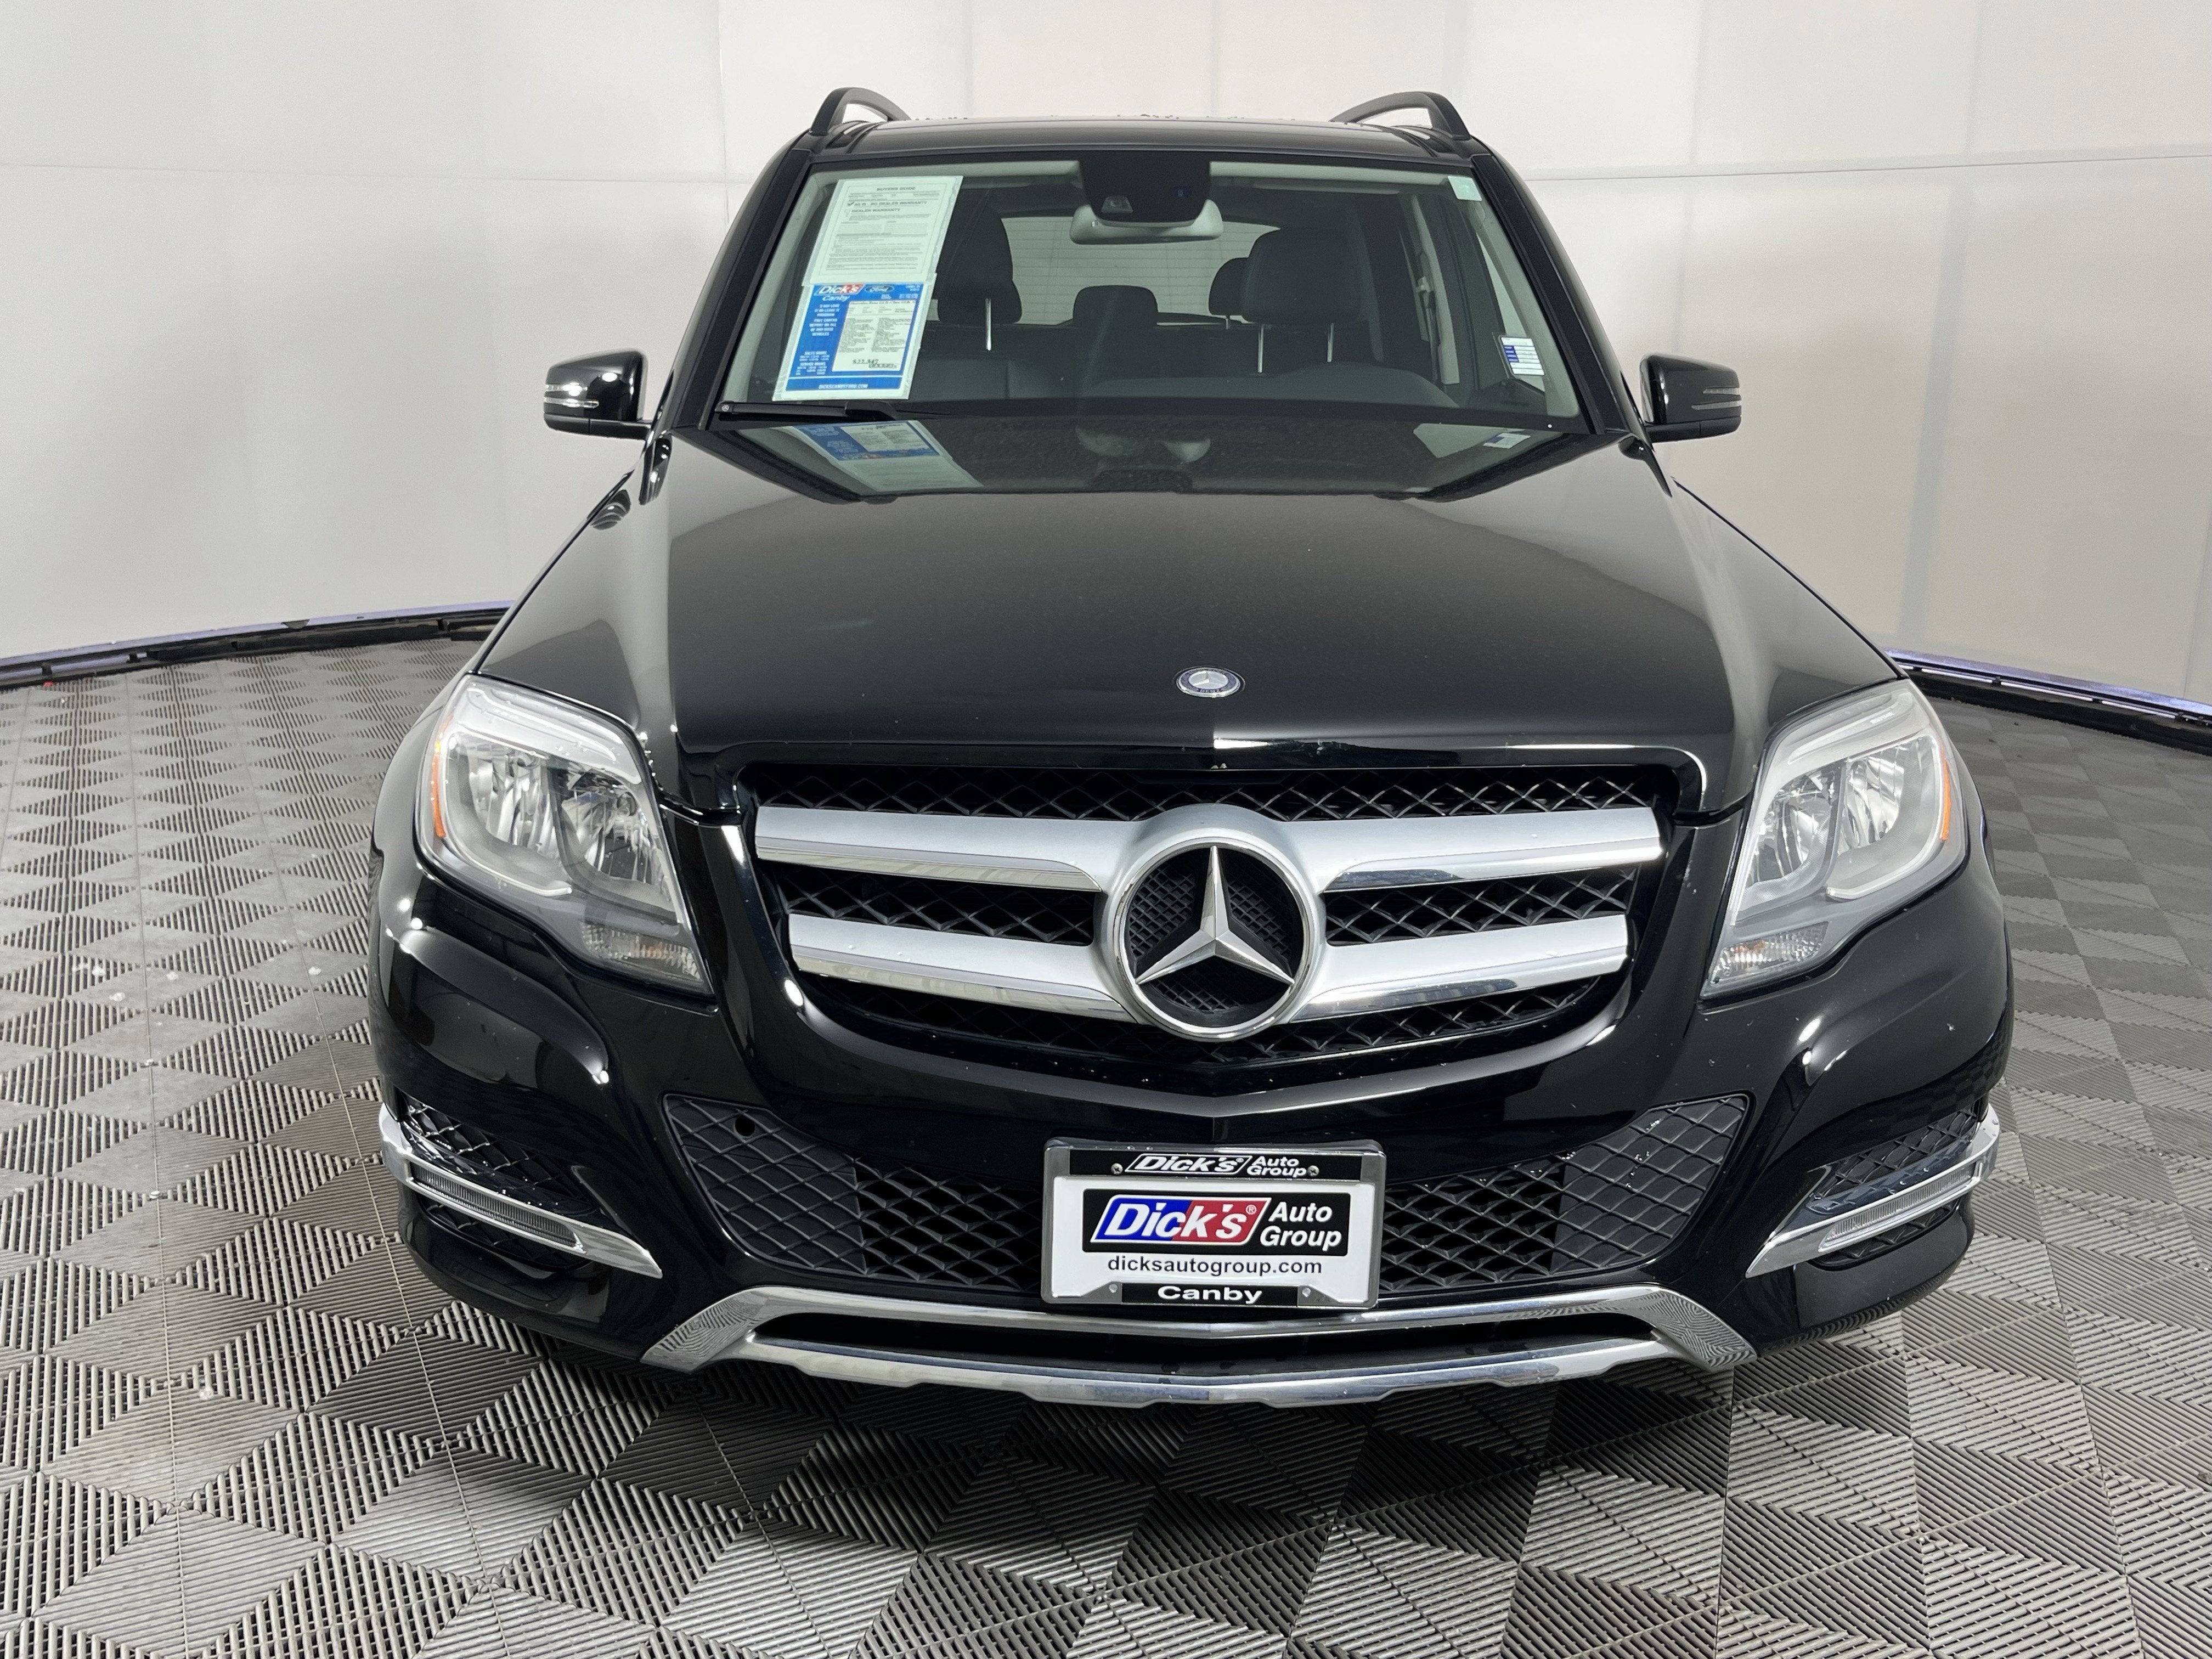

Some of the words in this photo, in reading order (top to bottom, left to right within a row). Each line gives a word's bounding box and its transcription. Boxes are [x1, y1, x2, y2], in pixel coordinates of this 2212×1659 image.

[1134, 1155, 1238, 1172] Dick's
[1251, 1155, 1300, 1167] Auto
[1246, 1165, 1308, 1178] Group
[1104, 1202, 1248, 1240] Dick's
[1268, 1201, 1333, 1223] Auto
[1260, 1225, 1342, 1251] Group
[1108, 1256, 1322, 1277] dicksautogroup.com
[1158, 1285, 1262, 1305] Canby
